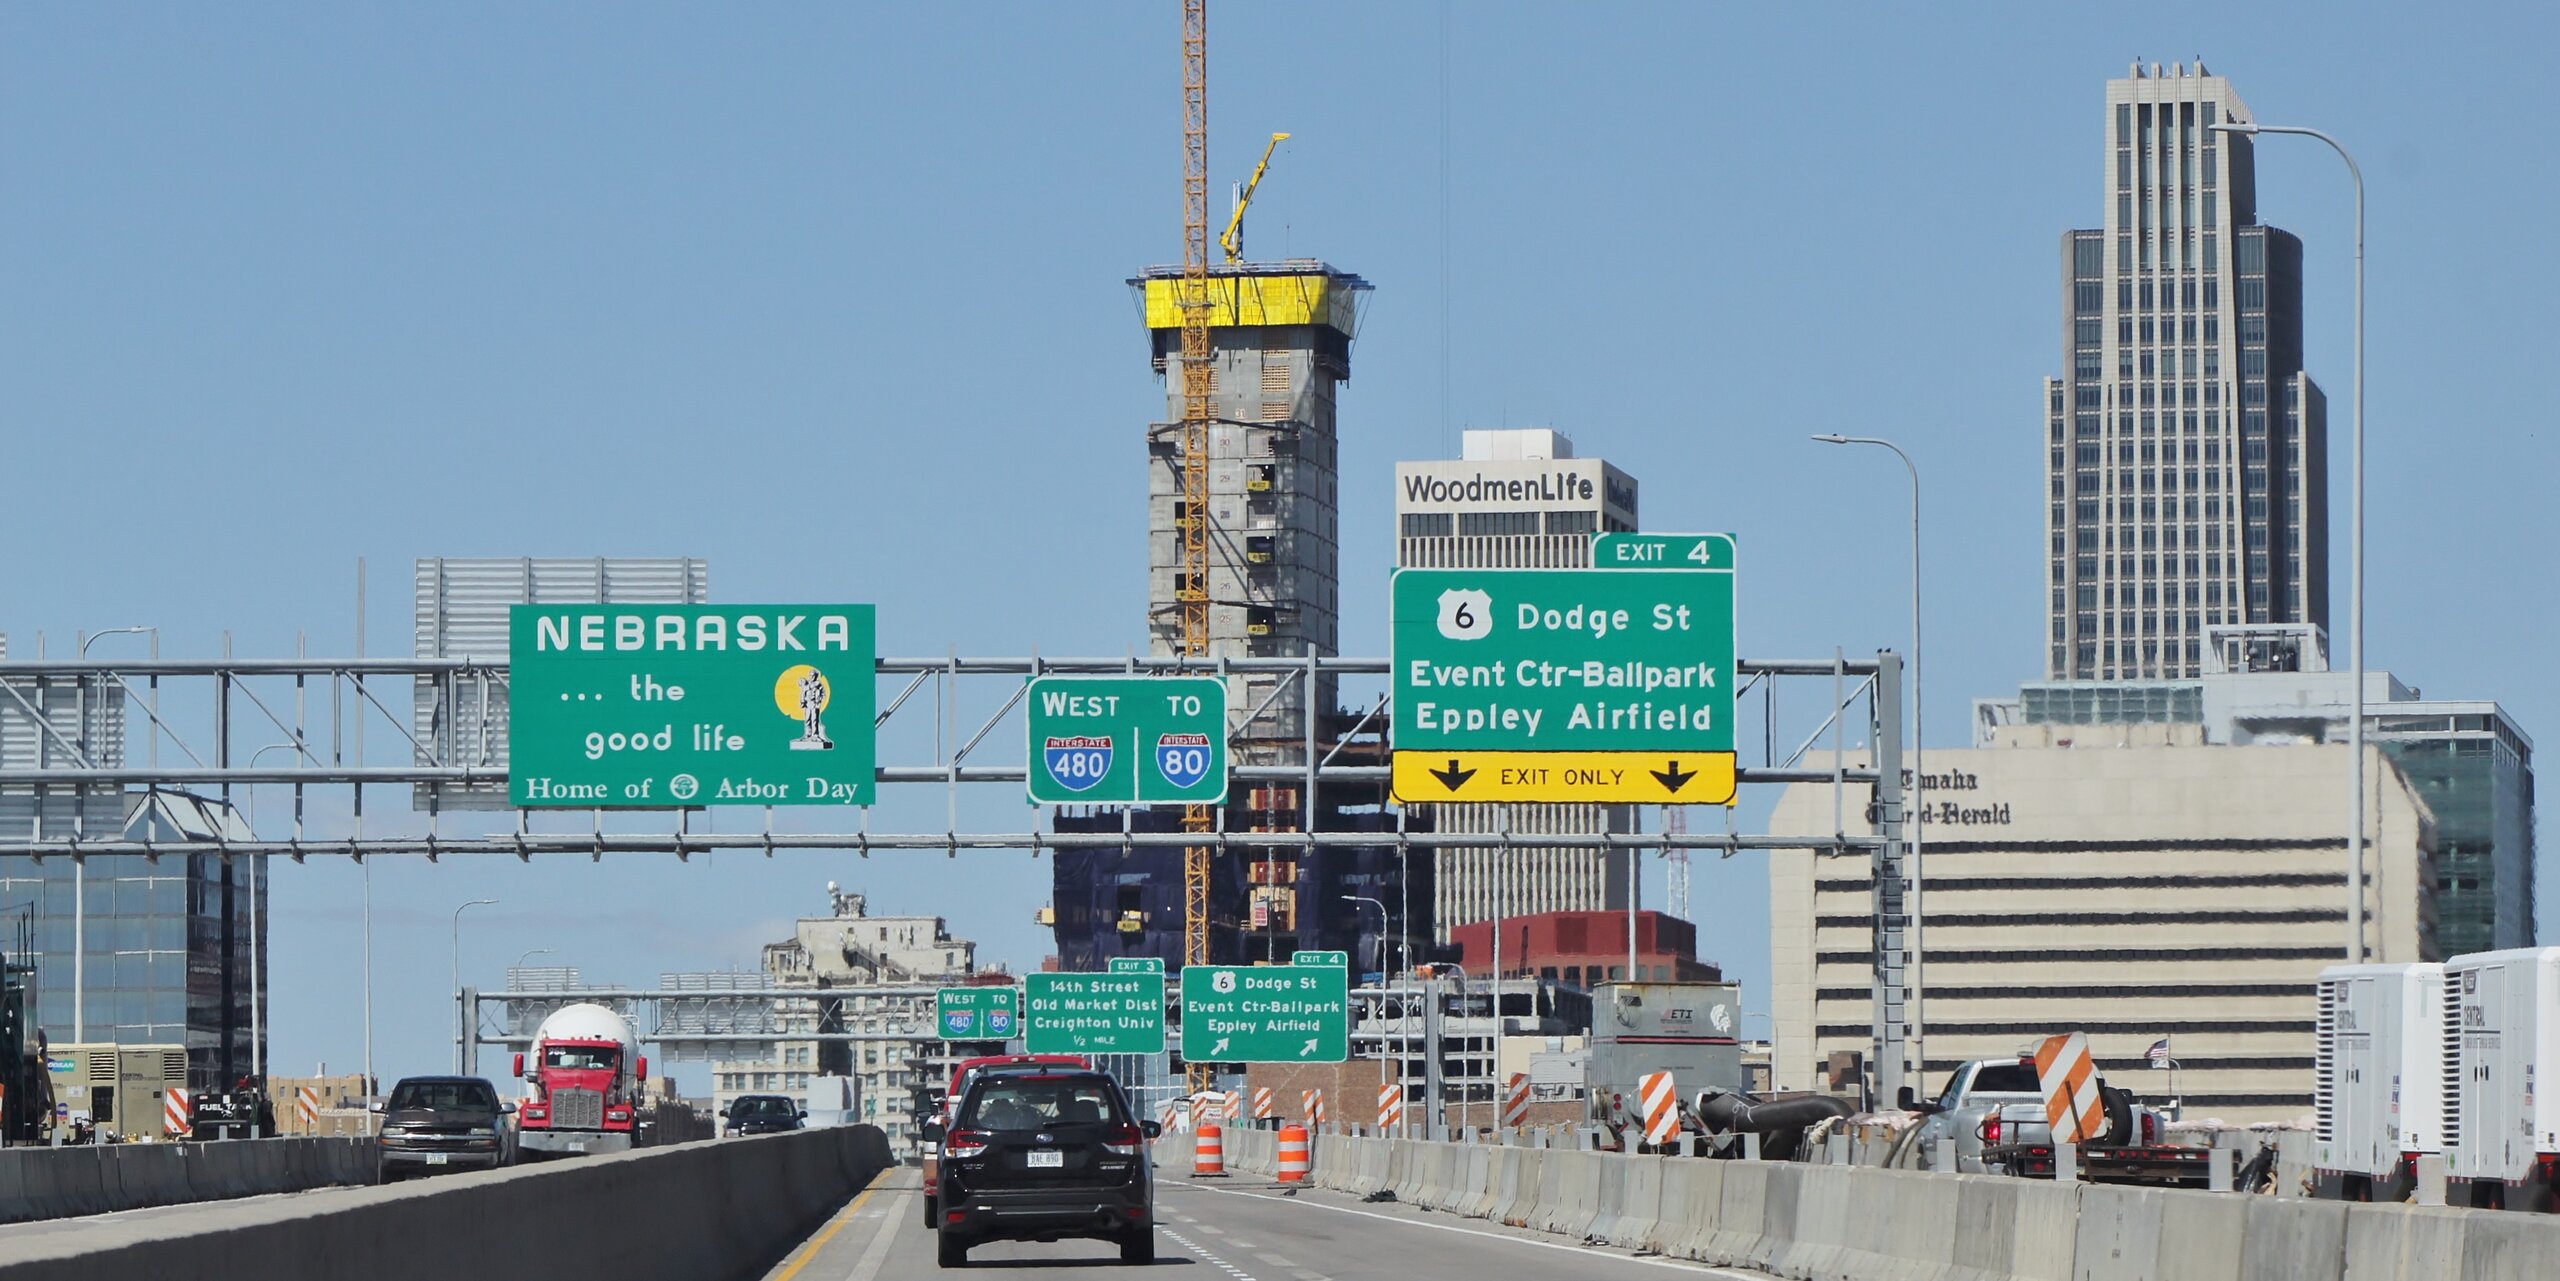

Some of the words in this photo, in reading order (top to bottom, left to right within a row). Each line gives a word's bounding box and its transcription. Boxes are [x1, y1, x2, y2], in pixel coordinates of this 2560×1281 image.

[1405, 473, 1593, 502] WoodmenLife
[1617, 544, 1665, 560] EXIT
[1688, 541, 1710, 564] 4
[1456, 602, 1474, 628] 6
[1519, 604, 1628, 638] Dodge
[1653, 604, 1690, 630] St
[538, 616, 848, 651] NEBRASKA
[1412, 660, 1505, 686] Event
[1517, 660, 1715, 692] Ctr-Ballpark
[632, 674, 684, 700] the
[1167, 696, 1200, 716] TO
[1417, 703, 1542, 736] Eppley
[1568, 702, 1710, 730] Airfield
[586, 725, 671, 759] good
[694, 724, 744, 750] life
[1050, 739, 1107, 748] INTERSTATE
[1163, 736, 1204, 745] INTERSTATE
[1055, 752, 1104, 778] 480
[1165, 749, 1203, 775] 80
[1502, 769, 1549, 784] EXIT
[1565, 770, 1623, 785] ONLY
[527, 778, 607, 798] Home
[625, 778, 652, 798] of
[716, 778, 788, 798] Arbor
[807, 778, 858, 804] Day
[1146, 961, 1155, 972] 3
[1329, 954, 1339, 964] 4
[1051, 981, 1082, 992] 14th
[1091, 981, 1139, 992] Street
[1220, 976, 1228, 989] 6
[1246, 978, 1291, 991] Dodge
[1301, 977, 1316, 988] St
[993, 995, 1007, 1004] TO
[1032, 999, 1057, 1010] Old
[1065, 999, 1117, 1010] Market
[1126, 999, 1157, 1010] Dist
[1189, 1001, 1233, 1012] Event
[1242, 1001, 1339, 1014] Ctr-Ballpark
[1671, 1009, 1693, 1019] ETI
[949, 1016, 969, 1027] 480
[992, 1016, 1008, 1027] 80
[1035, 1017, 1110, 1032] Creighton
[1119, 1017, 1153, 1028] Univ
[1209, 1019, 1256, 1033] Eppley
[1267, 1020, 1320, 1031] Airfield
[1095, 1036, 1114, 1044] MILE
[200, 1103, 223, 1111] FUEL
